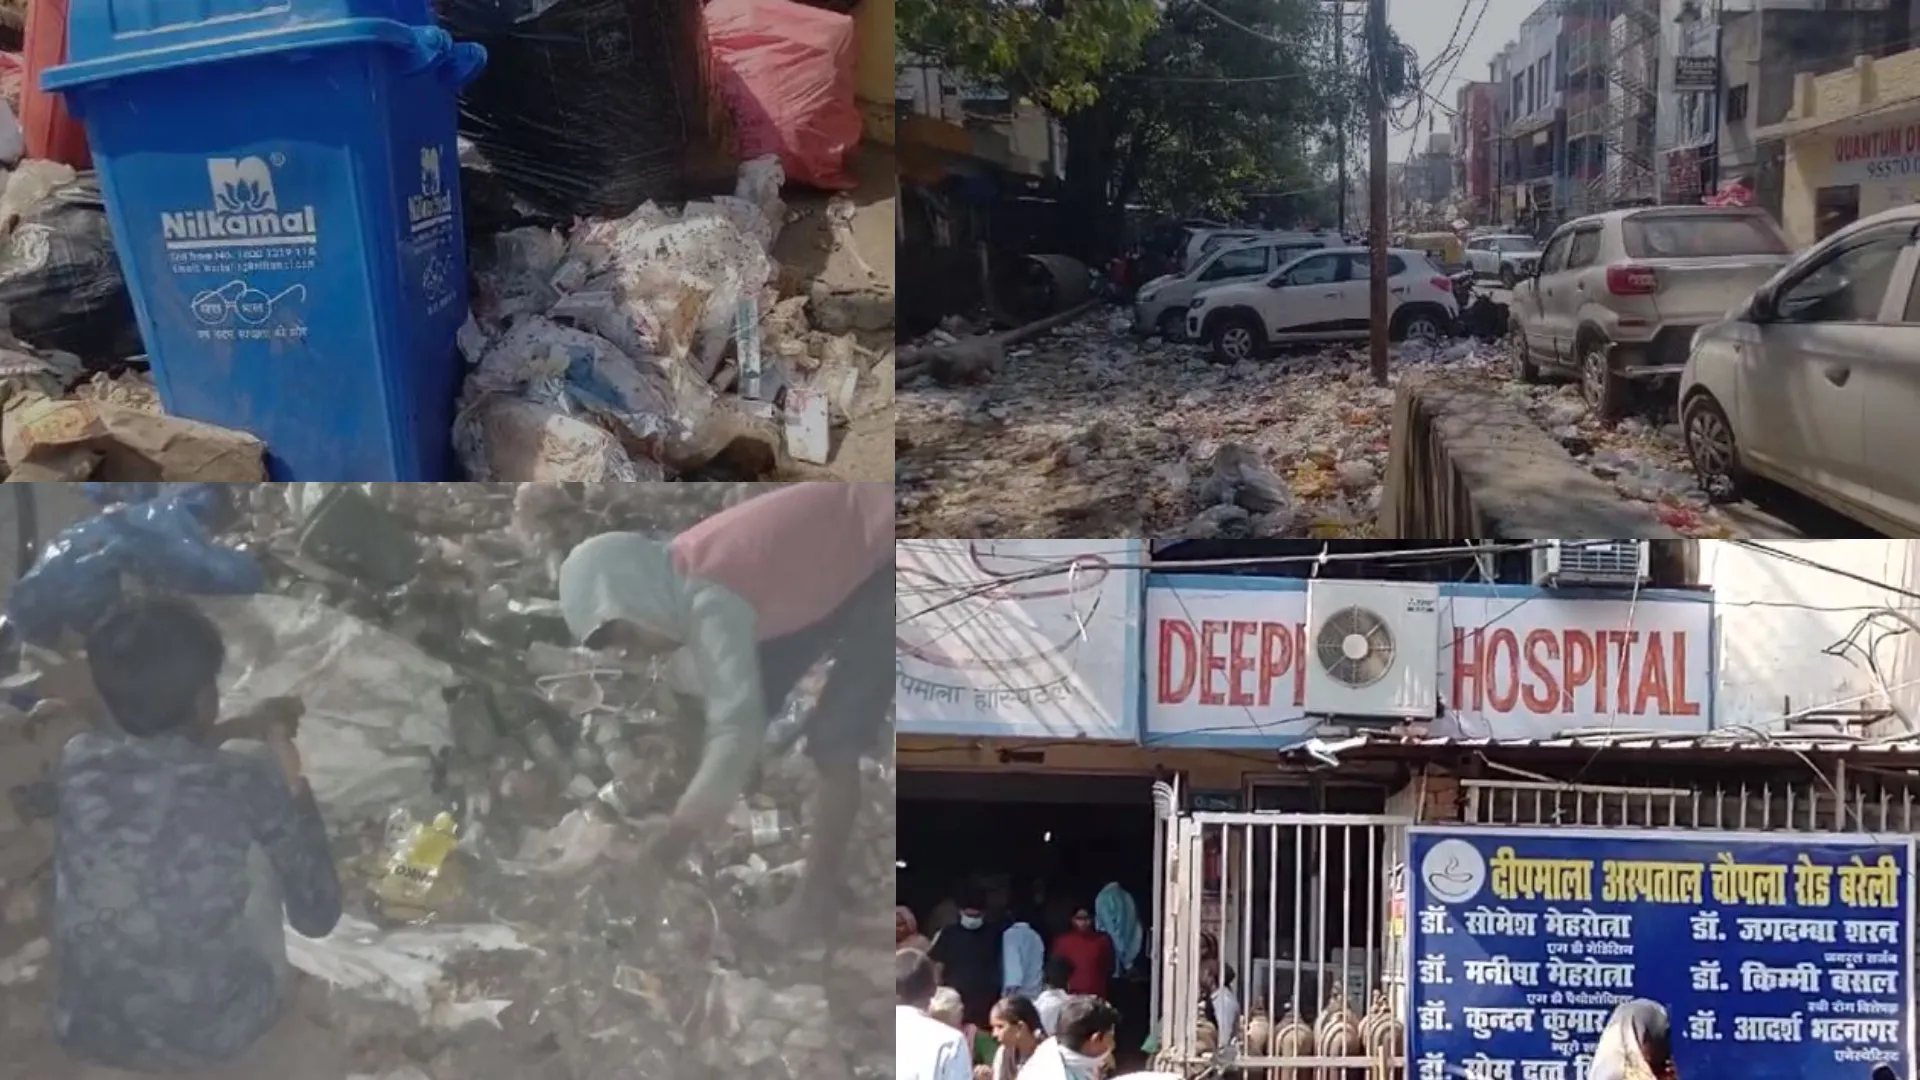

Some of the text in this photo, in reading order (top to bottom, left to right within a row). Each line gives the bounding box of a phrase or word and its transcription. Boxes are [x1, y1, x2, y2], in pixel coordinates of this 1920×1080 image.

[1834, 127, 1901, 162] QUANTUM
[161, 205, 316, 240] Nilkamal
[1158, 619, 1701, 716] DEEP HOSPITAL
[896, 672, 965, 705] पमाला
[1490, 846, 1901, 908] दीपमाला अस्पताल चौपला रोड बरेली
[1418, 905, 1633, 939] डॉ. सोमेश मेहरोत्रा
[1690, 911, 1899, 944] डॉ. जगदम्बा शरन
[1417, 954, 1635, 988] डॉ. मनीषा मेहरोत्रा
[1690, 960, 1899, 994] डॉ. किम्मी बंसल
[1417, 1001, 1609, 1040] डॉ. कुन्दन कुमार
[1688, 1010, 1899, 1043] डॉ. आदर्श भटनागर
